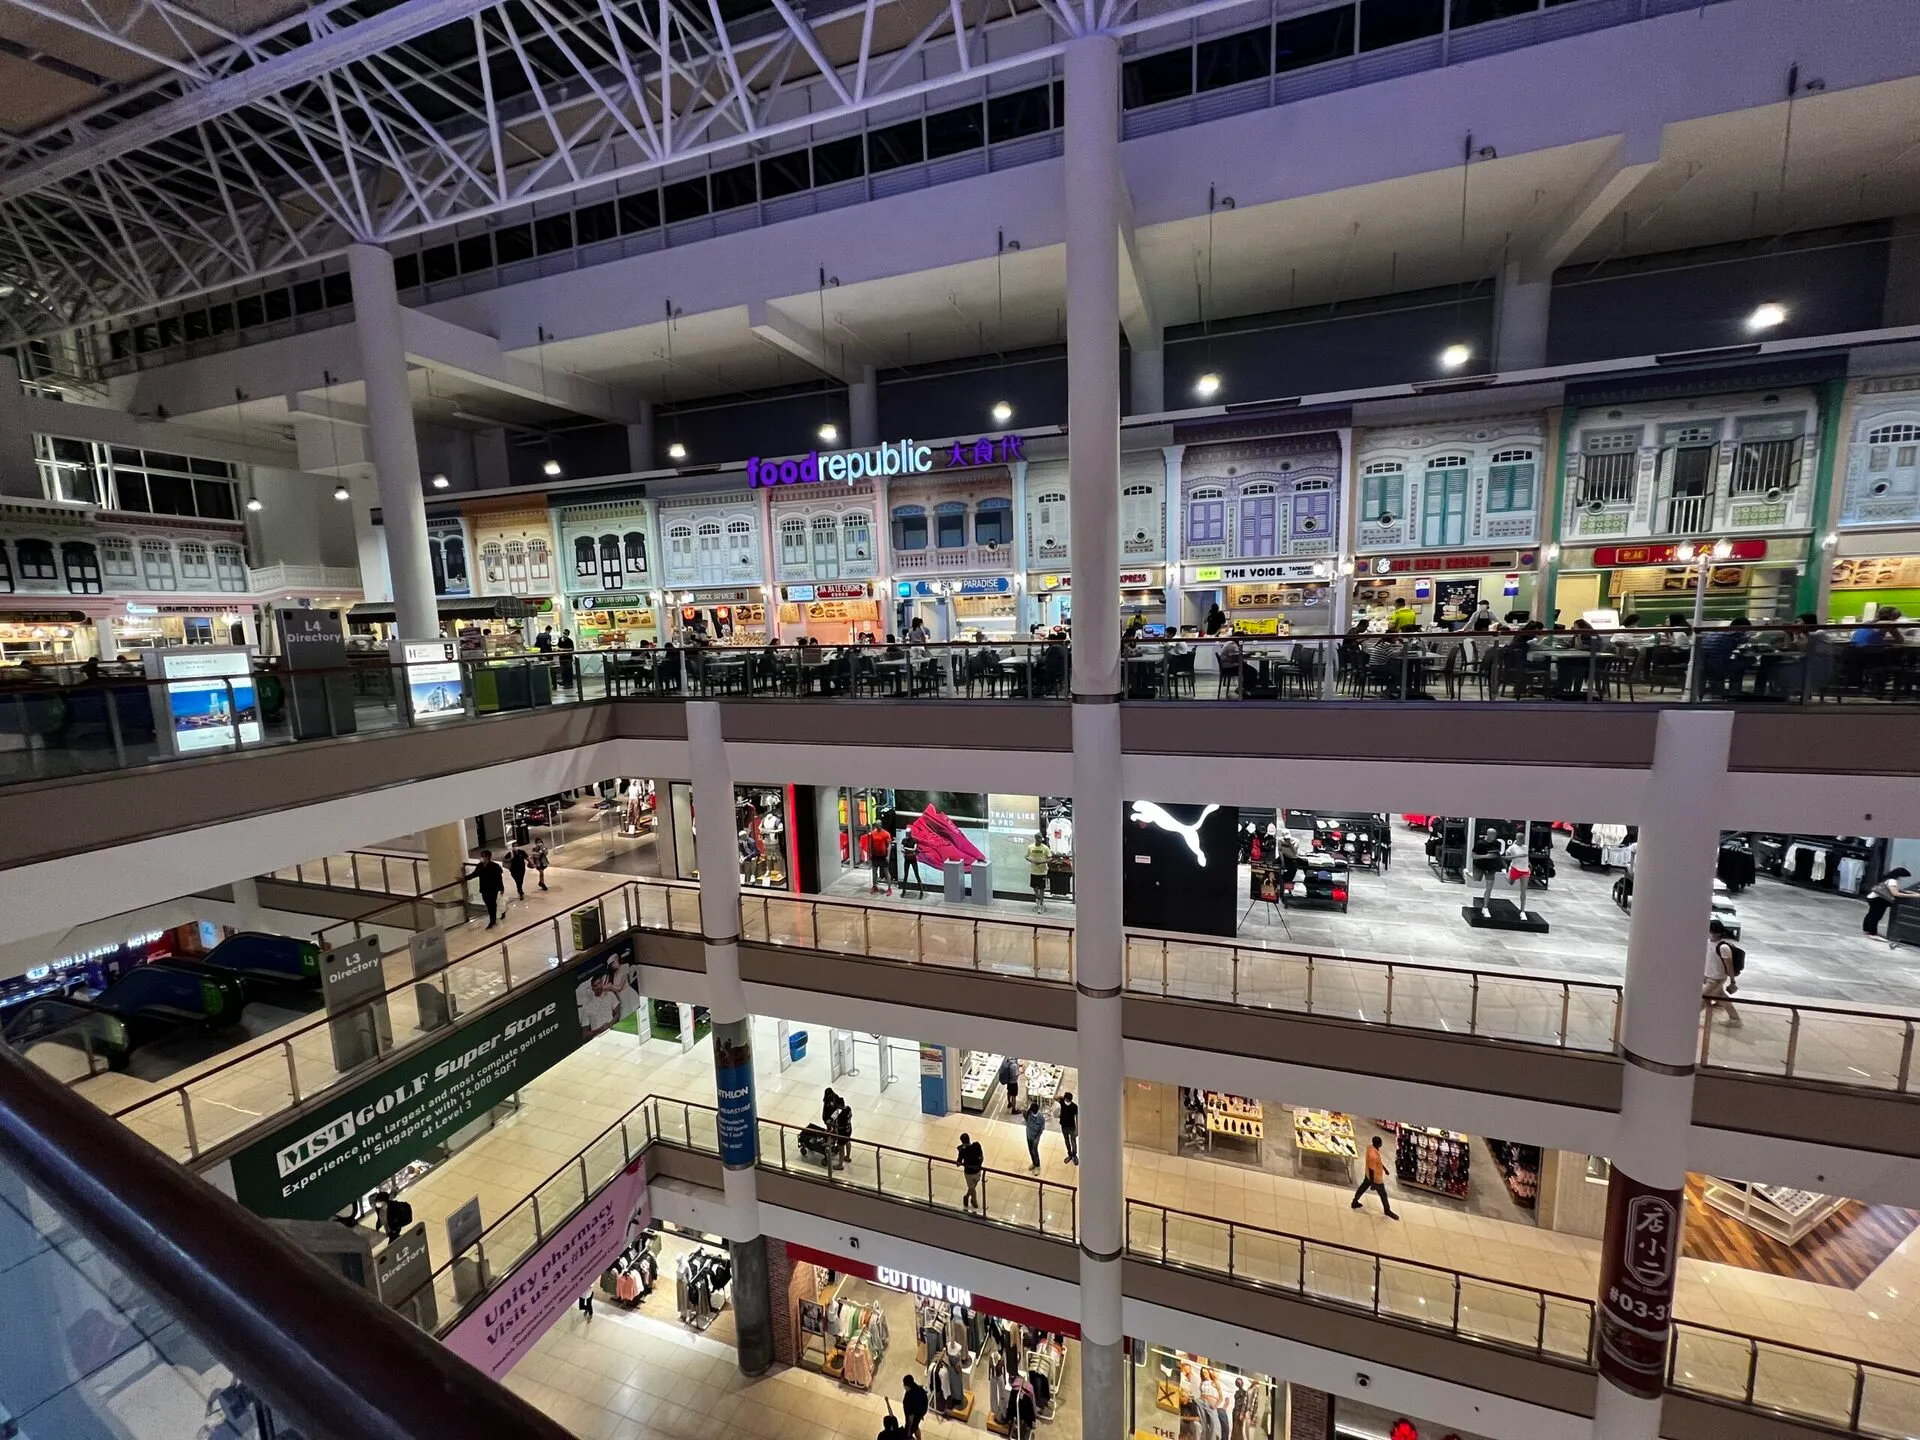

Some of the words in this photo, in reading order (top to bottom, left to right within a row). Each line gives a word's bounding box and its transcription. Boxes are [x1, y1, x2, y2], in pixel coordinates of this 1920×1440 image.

[748, 439, 932, 488] foodrepublic
[946, 434, 1025, 467] 大食代
[963, 579, 998, 589] PARADISE
[1224, 569, 1246, 578] THE
[287, 633, 341, 643] Directory
[304, 620, 322, 632] L4
[990, 811, 1014, 819] TRAIN
[328, 957, 379, 984] Directory
[345, 952, 361, 967] L3
[434, 1034, 501, 1083] Super
[504, 1002, 556, 1041] Store
[282, 1146, 359, 1198] Experience
[362, 1132, 382, 1149] the
[385, 1103, 426, 1135] largest
[428, 1089, 447, 1107] and
[450, 1073, 474, 1094] most
[477, 1048, 519, 1077] complete
[519, 1034, 536, 1053] golf
[538, 1022, 559, 1040] store
[358, 1153, 371, 1165] in
[374, 1114, 432, 1156] Singapore
[434, 1099, 457, 1116] with
[494, 1058, 518, 1079] SQFT
[422, 1127, 433, 1138] at
[435, 1105, 464, 1130] Level
[466, 1100, 472, 1110] 3
[381, 1244, 426, 1284] Directory
[484, 1272, 537, 1328] Unity
[541, 1200, 613, 1278] pharmacy
[486, 1303, 527, 1345] Visit
[531, 1282, 549, 1304] us
[552, 1262, 572, 1285] at
[878, 1265, 943, 1300] COTTON
[946, 1285, 971, 1308] ON
[1153, 1426, 1176, 1440] THE
